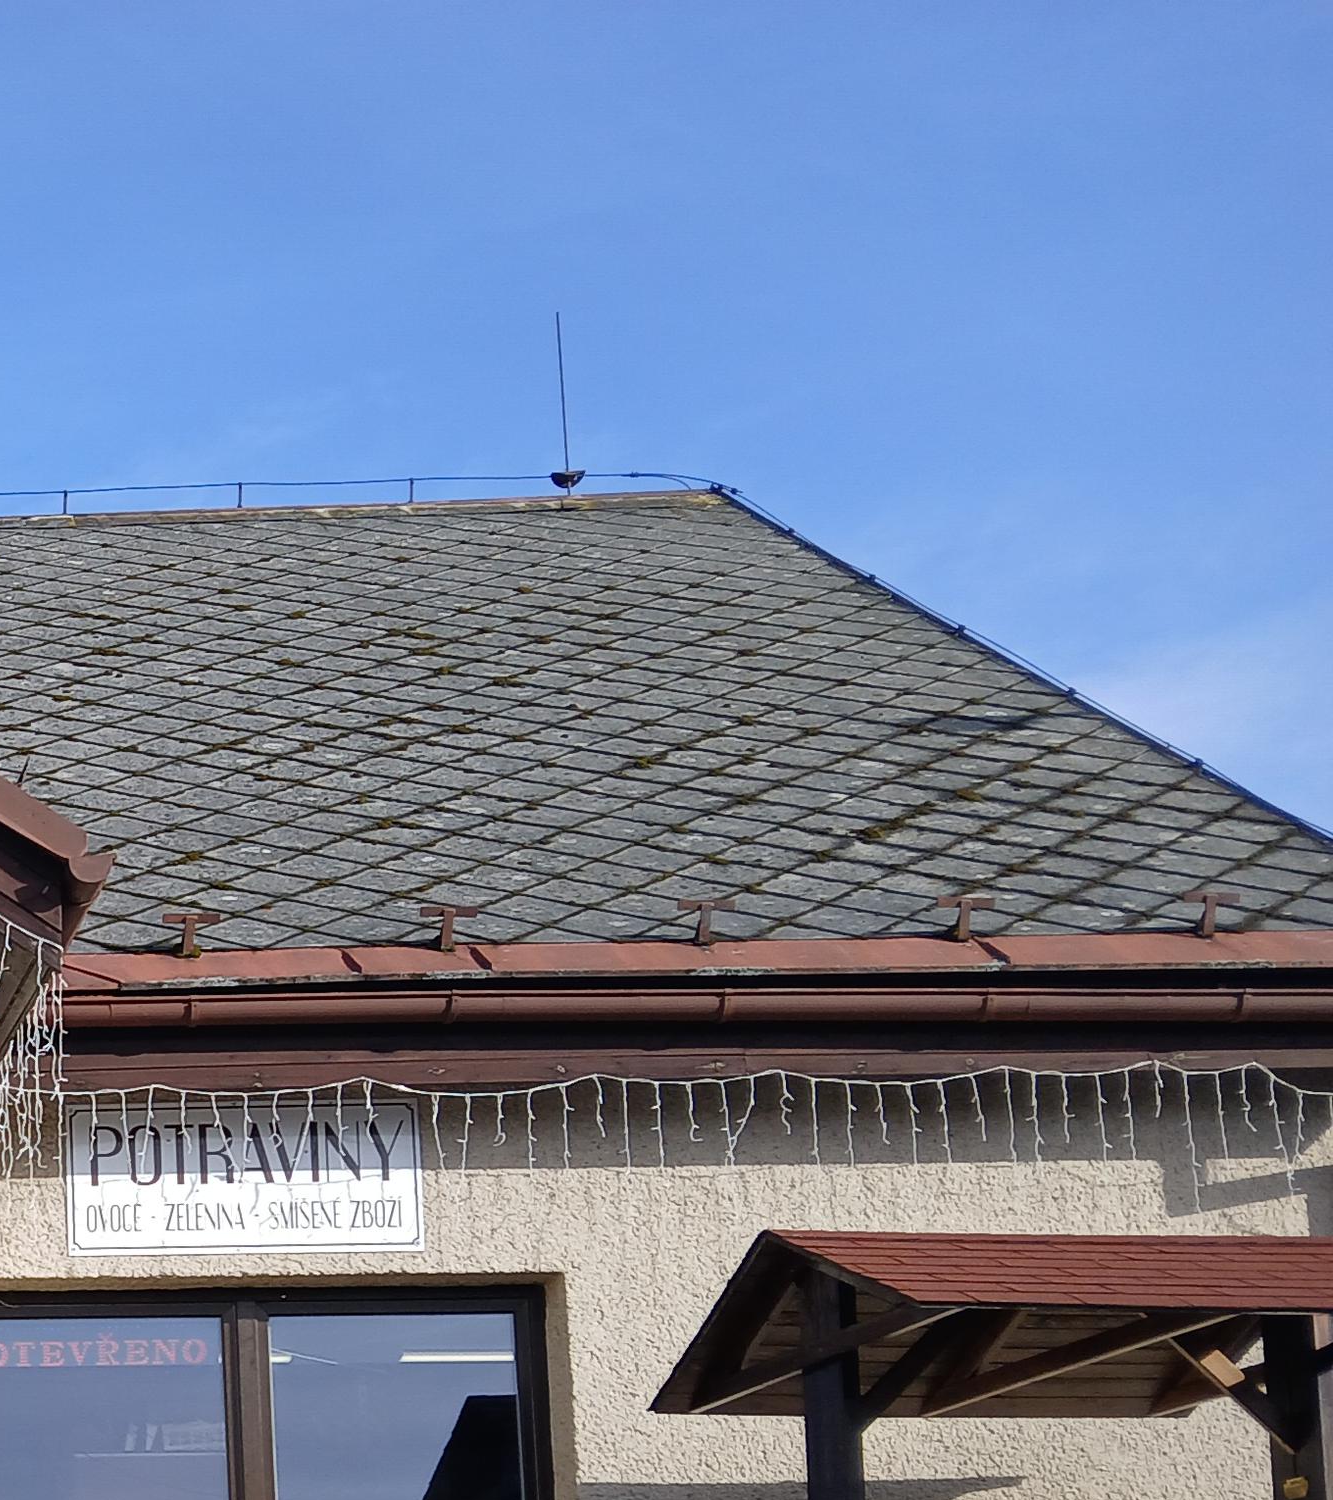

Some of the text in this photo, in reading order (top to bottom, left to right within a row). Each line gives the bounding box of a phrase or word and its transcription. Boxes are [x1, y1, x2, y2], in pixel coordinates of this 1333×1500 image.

[89, 1120, 404, 1186] POTRAVINY
[87, 1203, 142, 1232] OVOCE
[350, 1196, 402, 1228] ZBOŽÍ
